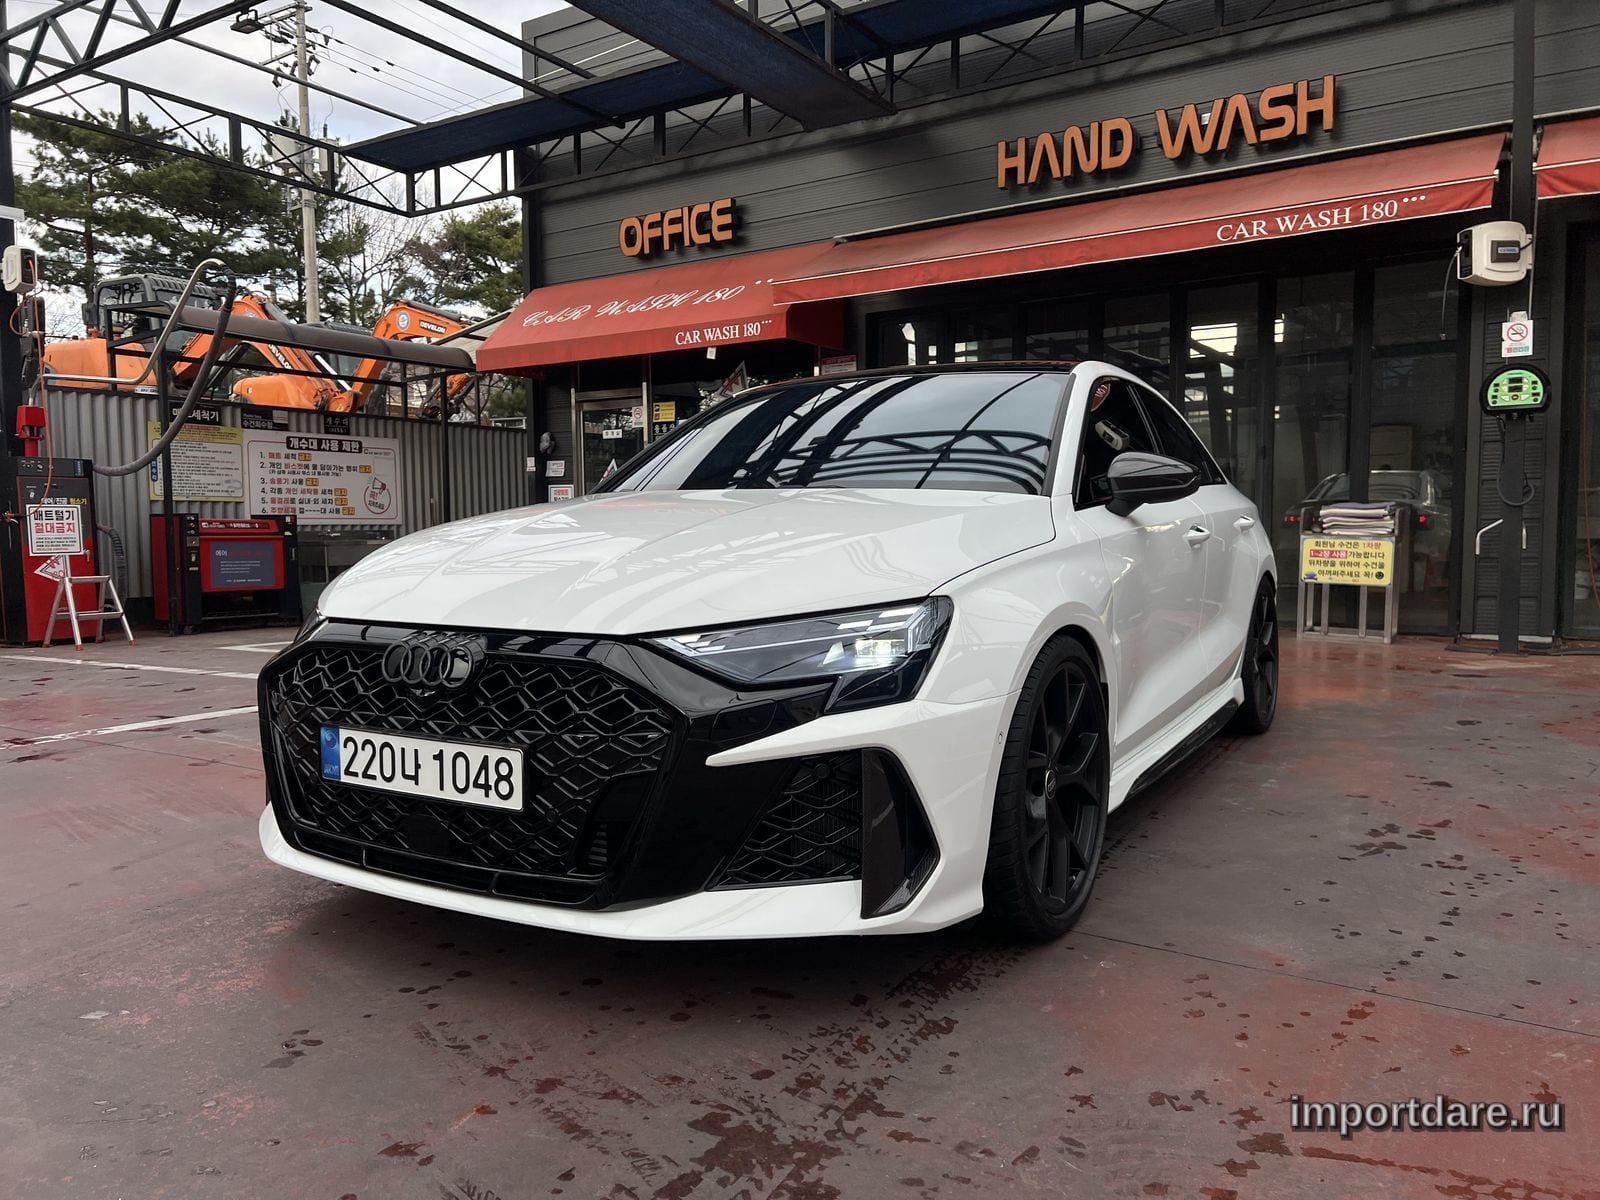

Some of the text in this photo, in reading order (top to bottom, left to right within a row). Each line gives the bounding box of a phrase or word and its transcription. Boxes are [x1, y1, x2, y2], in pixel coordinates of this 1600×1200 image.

[997, 74, 1336, 188] HAND WASH
[619, 198, 735, 257] OFFICE
[1216, 219, 1268, 242] CAR
[1274, 207, 1350, 232] WASH
[522, 304, 592, 328] CAR
[595, 288, 700, 318] WASH
[675, 330, 702, 346] CAR
[703, 326, 740, 342] WASH
[172, 408, 219, 422] 매세척기
[289, 438, 318, 450] 개수대
[321, 440, 340, 450] 사용
[342, 441, 360, 452] 제한
[34, 510, 74, 521] 매트털기
[35, 522, 76, 534] 절대금지
[344, 736, 514, 800] 220나 1048
